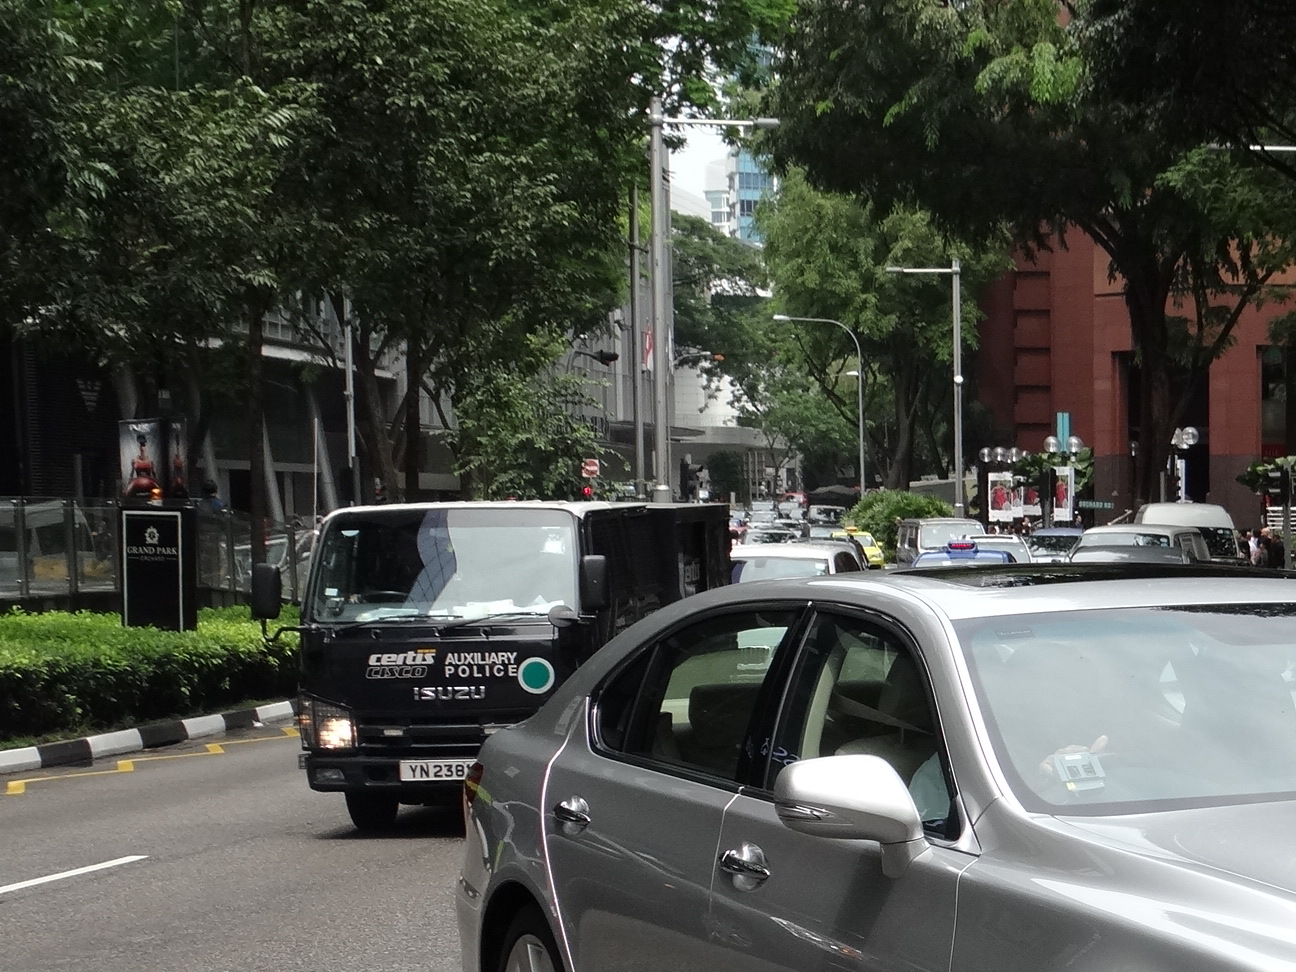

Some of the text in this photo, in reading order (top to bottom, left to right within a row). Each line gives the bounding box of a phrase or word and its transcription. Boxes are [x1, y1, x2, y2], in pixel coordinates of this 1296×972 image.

[127, 546, 178, 555] GRAND PARK
[368, 649, 437, 666] certis
[445, 652, 518, 665] AUXILIARY
[366, 666, 428, 679] CISCO
[445, 665, 518, 678] POLICE
[413, 685, 486, 701] ISUZU
[409, 763, 471, 778] YN 238
